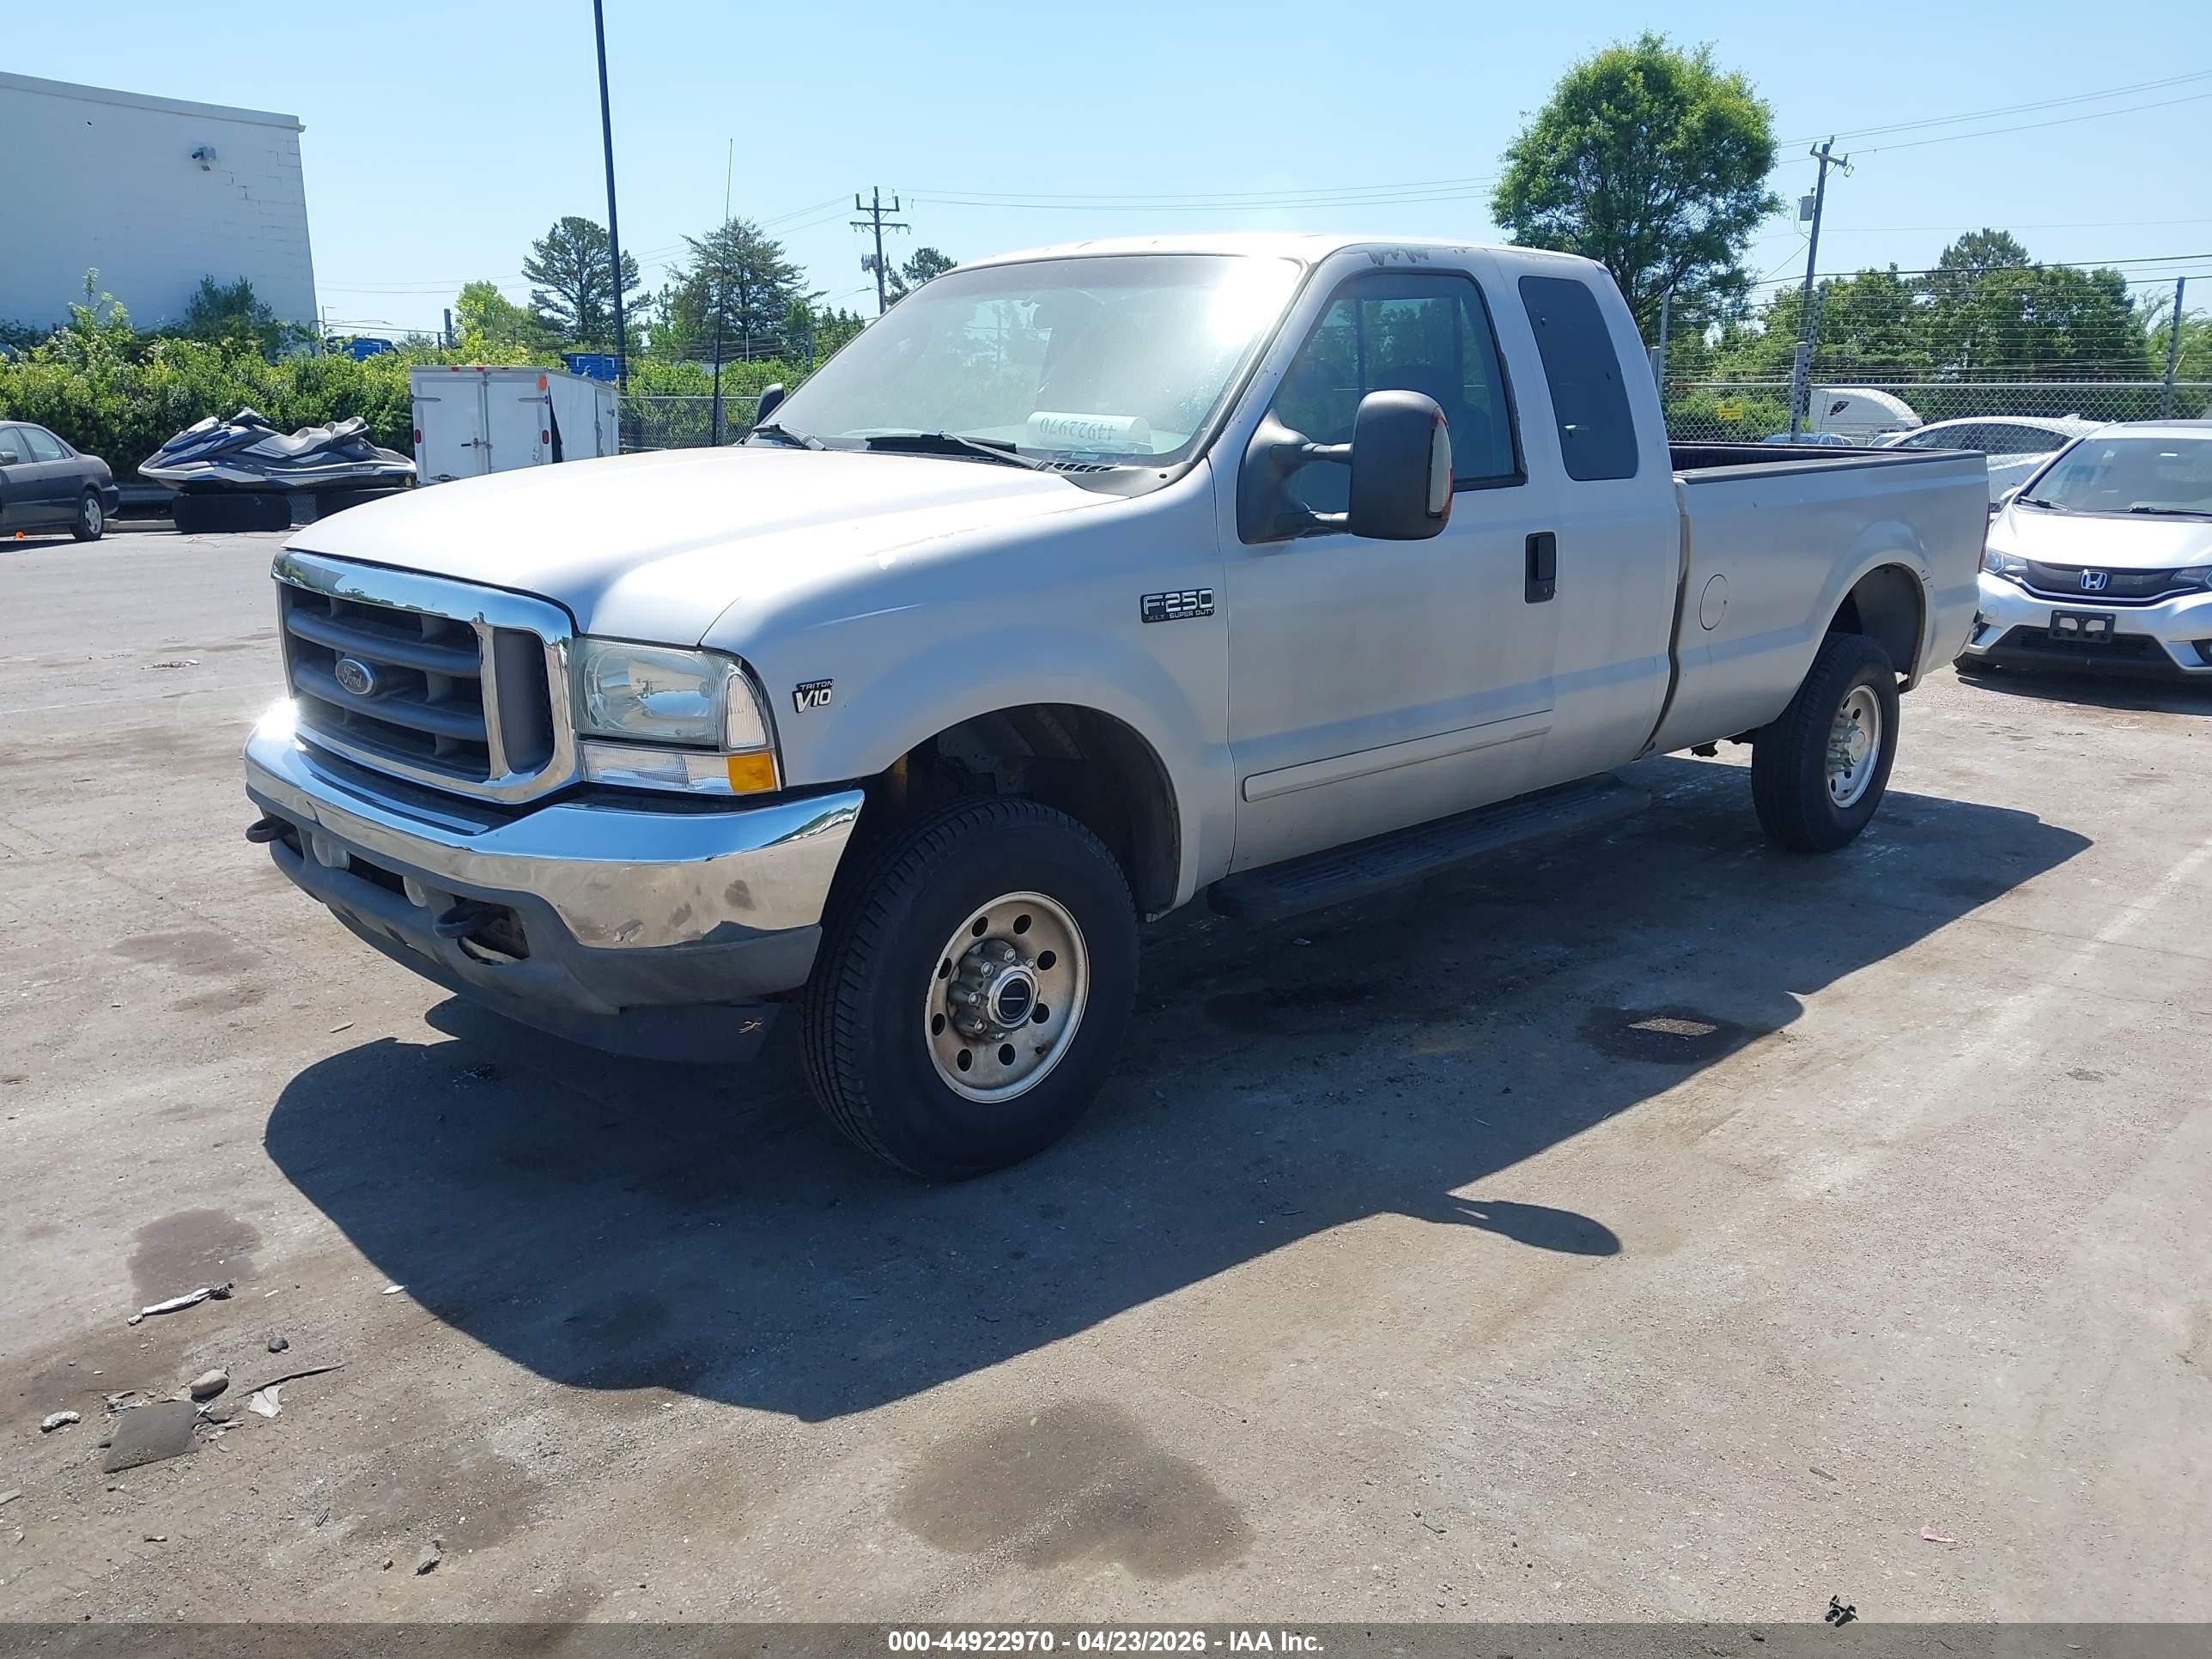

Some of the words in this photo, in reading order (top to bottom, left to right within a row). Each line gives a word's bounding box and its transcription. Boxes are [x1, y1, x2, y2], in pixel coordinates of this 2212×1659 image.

[1039, 417, 1117, 441] 44922970
[1143, 589, 1214, 615] F-250
[1169, 611, 1194, 619] SUPER
[343, 665, 364, 688] Ford
[799, 680, 834, 690] TRITON
[795, 688, 832, 713] V10
